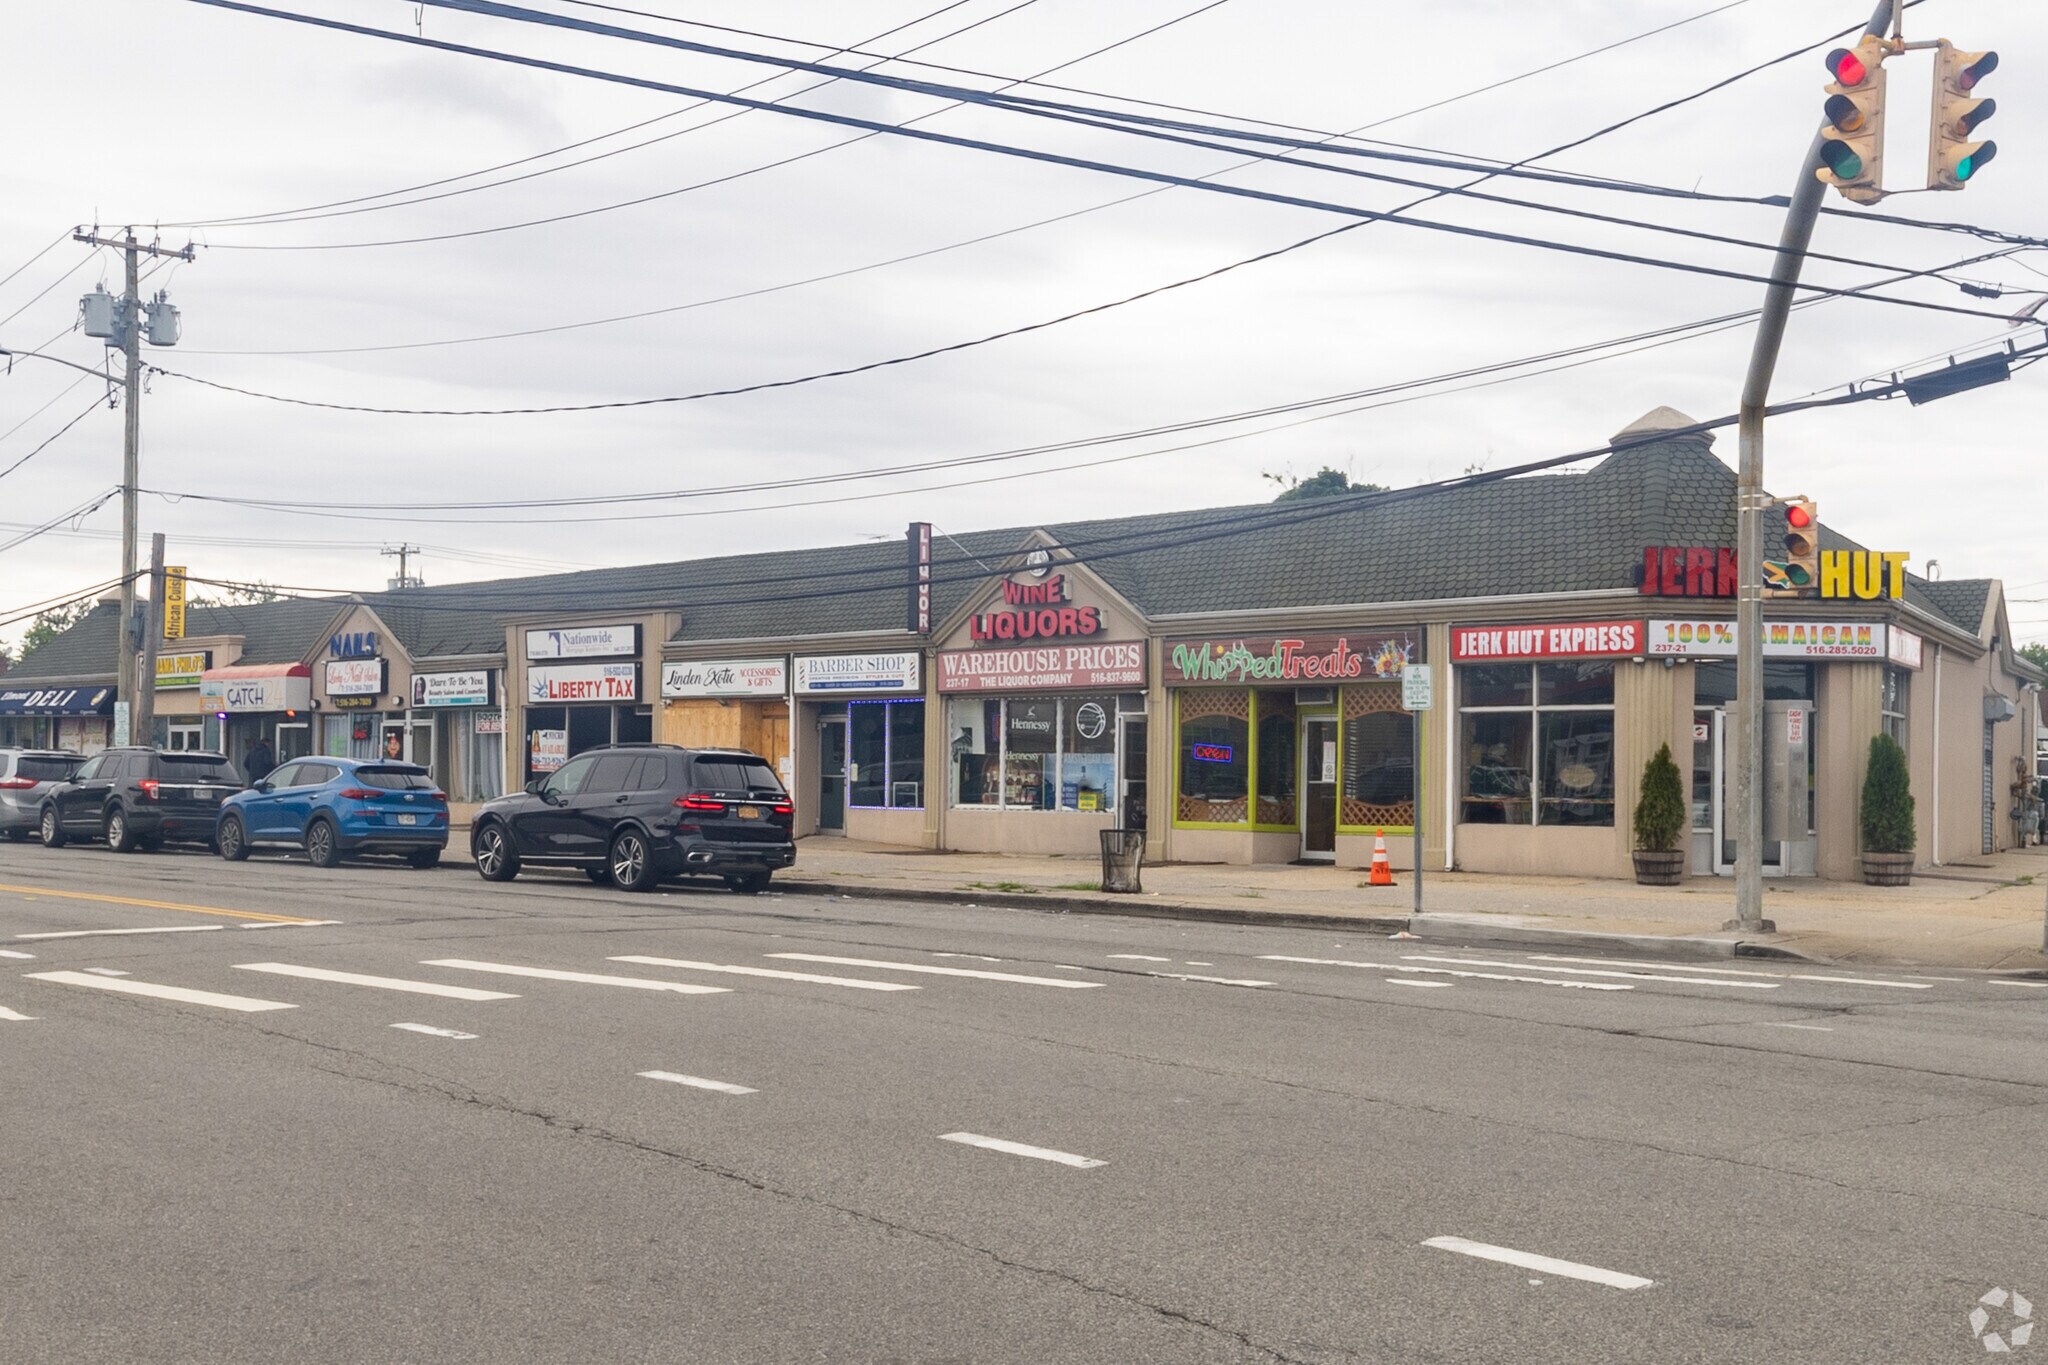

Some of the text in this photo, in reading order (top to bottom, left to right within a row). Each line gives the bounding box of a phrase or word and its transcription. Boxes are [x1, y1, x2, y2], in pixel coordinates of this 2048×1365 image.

[919, 527, 929, 628] LIQUOR
[1640, 546, 1910, 600] JERK HUT
[1002, 574, 1062, 605] WINE
[167, 568, 182, 637] African Cuisie
[970, 606, 1098, 641] LIQUORS
[330, 631, 375, 657] NAILS
[563, 631, 613, 645] Nationwide
[1459, 625, 1635, 656] JERK HUT EXPRESS
[1664, 623, 1733, 644] 100%
[1762, 624, 1872, 645] MAICAN
[1655, 644, 1877, 655] 237-21 516.285.5020
[156, 657, 175, 674] AMA
[809, 656, 905, 673] BARBER SHOP
[943, 645, 1140, 676] WAREHOUSE PRICES
[429, 676, 484, 687] Dare To Be You
[666, 667, 735, 690] Linden Exotic
[740, 667, 782, 678] ACCESSORIES
[754, 678, 772, 686] GIFTS
[946, 677, 969, 688] 237-17
[980, 676, 996, 687] THE
[998, 676, 1029, 687] LIQUOR
[1029, 674, 1073, 686] COMPANY
[23, 690, 77, 706] DELI
[227, 687, 264, 707] CATCH
[549, 677, 633, 699] LIBERTY TAX
[1011, 718, 1051, 732] Hennessy
[1005, 751, 1039, 763] Hennessy
